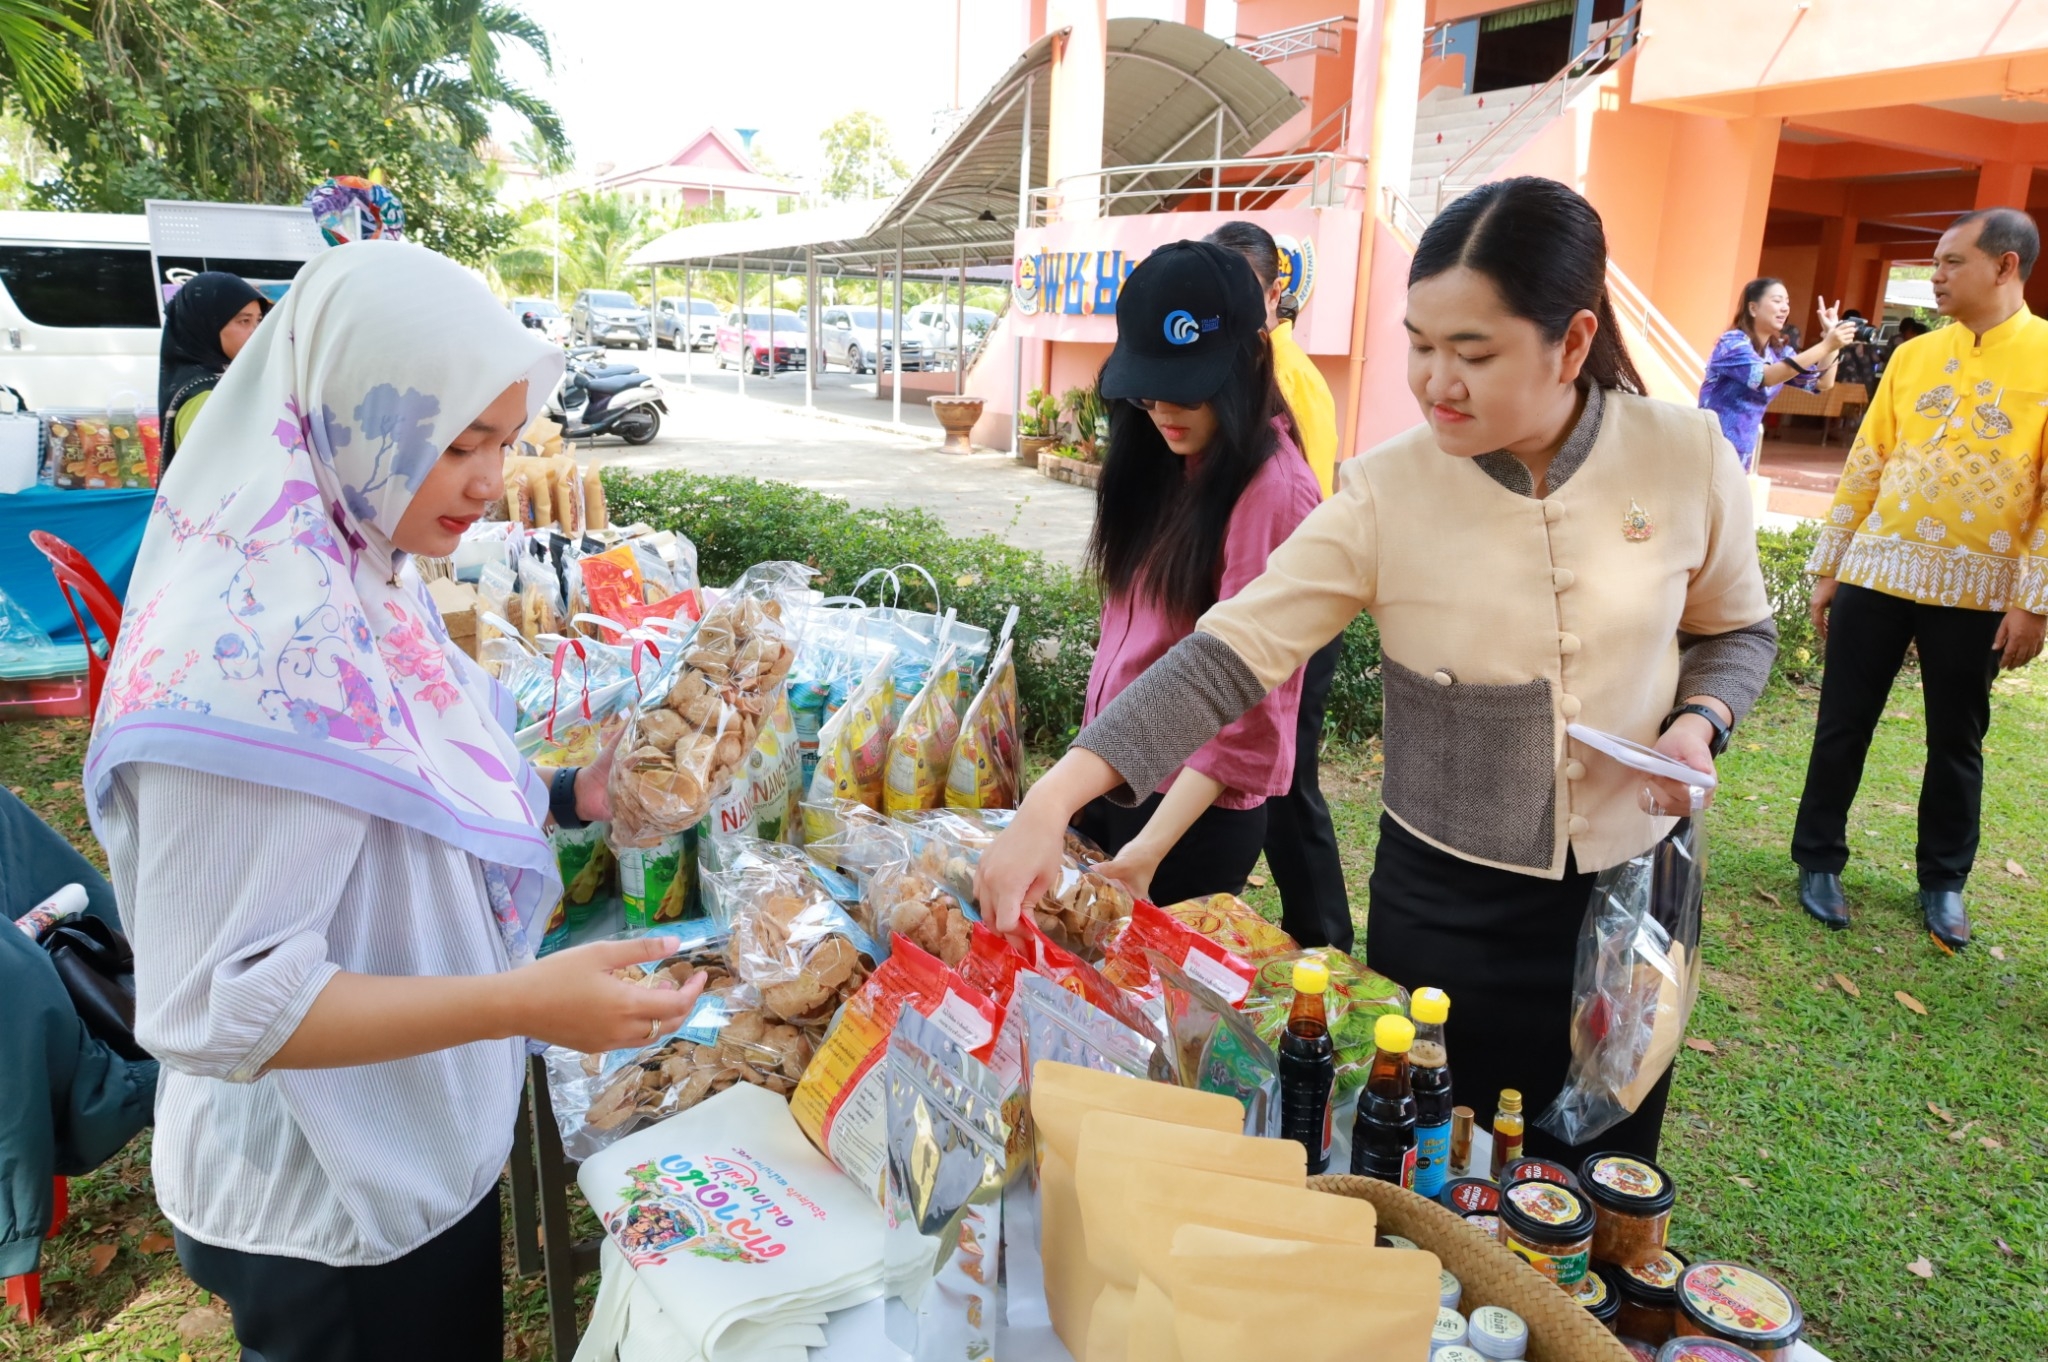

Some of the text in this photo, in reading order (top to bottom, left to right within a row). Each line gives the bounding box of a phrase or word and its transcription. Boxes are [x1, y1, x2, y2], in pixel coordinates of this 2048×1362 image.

[1299, 241, 1314, 301] DEPARTMENT
[721, 792, 754, 833] NAN
[752, 764, 787, 804] NANG
[659, 1153, 787, 1258] ตลาดนัด
[704, 1156, 794, 1228] คนไทยยิ้มได้
